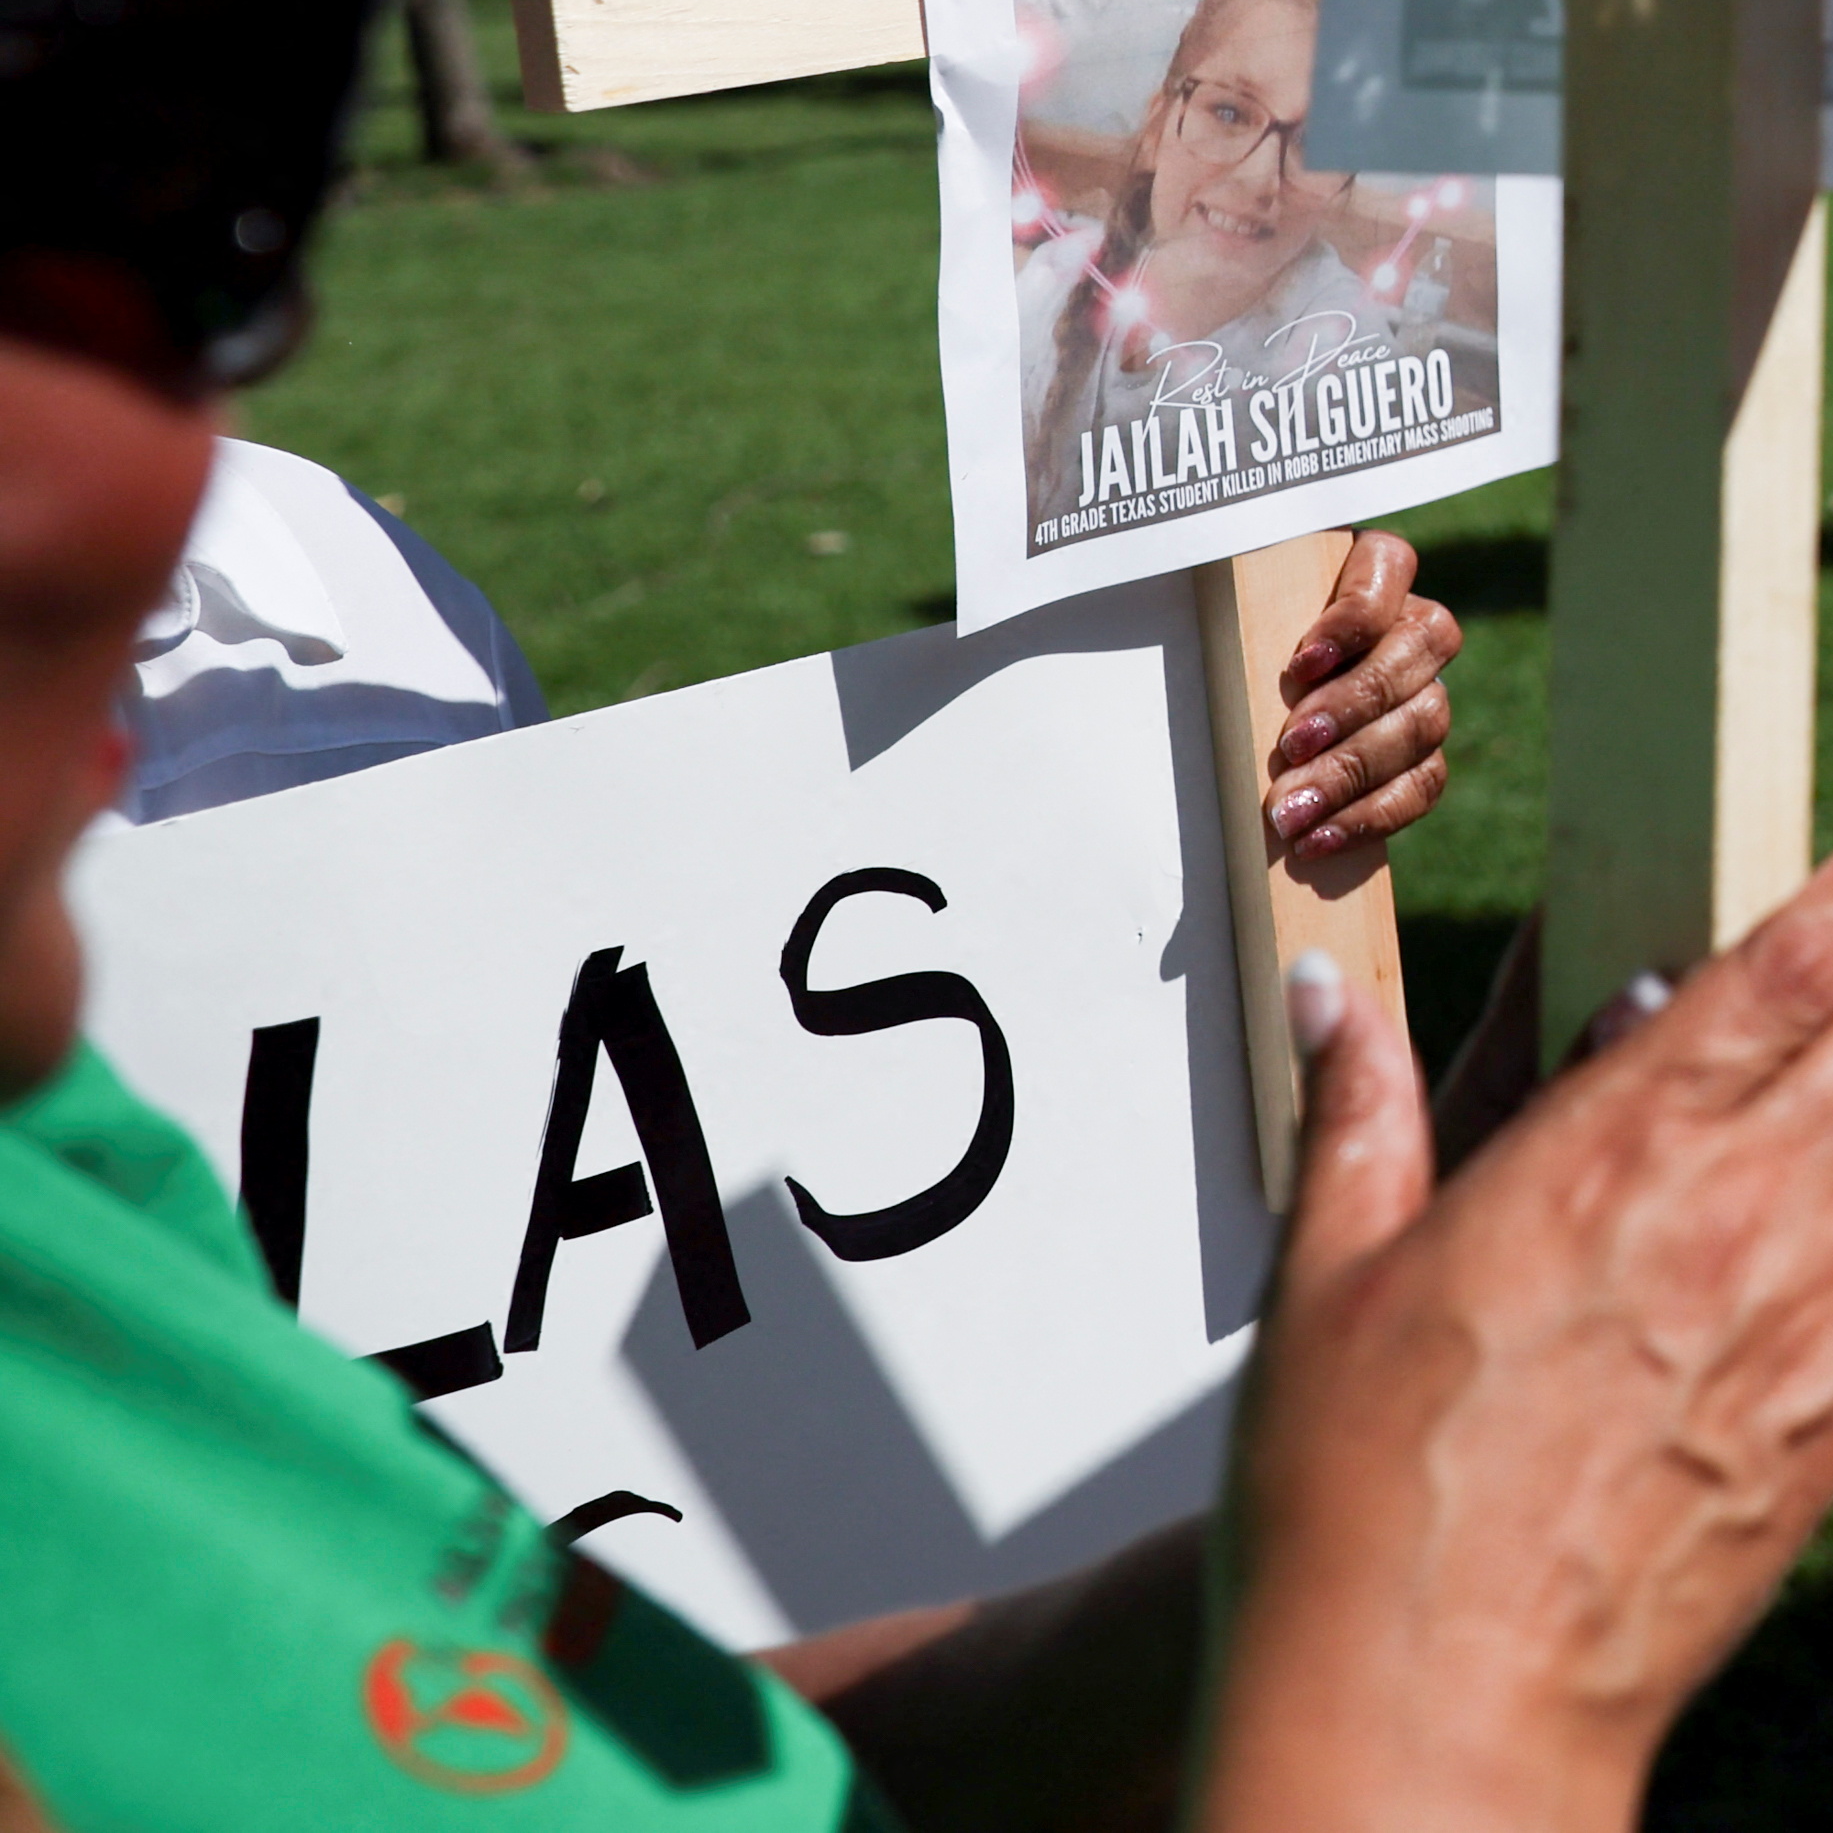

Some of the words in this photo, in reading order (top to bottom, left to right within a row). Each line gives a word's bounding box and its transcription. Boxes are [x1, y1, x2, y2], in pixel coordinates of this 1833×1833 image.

[1078, 398, 1238, 508] JAILAH
[1249, 348, 1454, 464] SILGUERO
[1145, 340, 1230, 442] Rest
[1240, 370, 1269, 391] in
[1263, 309, 1391, 411] Peace
[1034, 517, 1060, 546] 4TH
[1061, 507, 1108, 537] GRADE
[1109, 493, 1156, 526] TEXAS
[1159, 477, 1219, 514] STUDENT
[1222, 466, 1265, 499] KILLED
[1267, 462, 1284, 486] IN
[1285, 452, 1319, 481] ROBB
[1321, 431, 1403, 472] ELEMENTARY
[1404, 425, 1439, 452] MASS
[1440, 406, 1494, 439] SHOOTING
[238, 866, 1015, 1404] LAS
